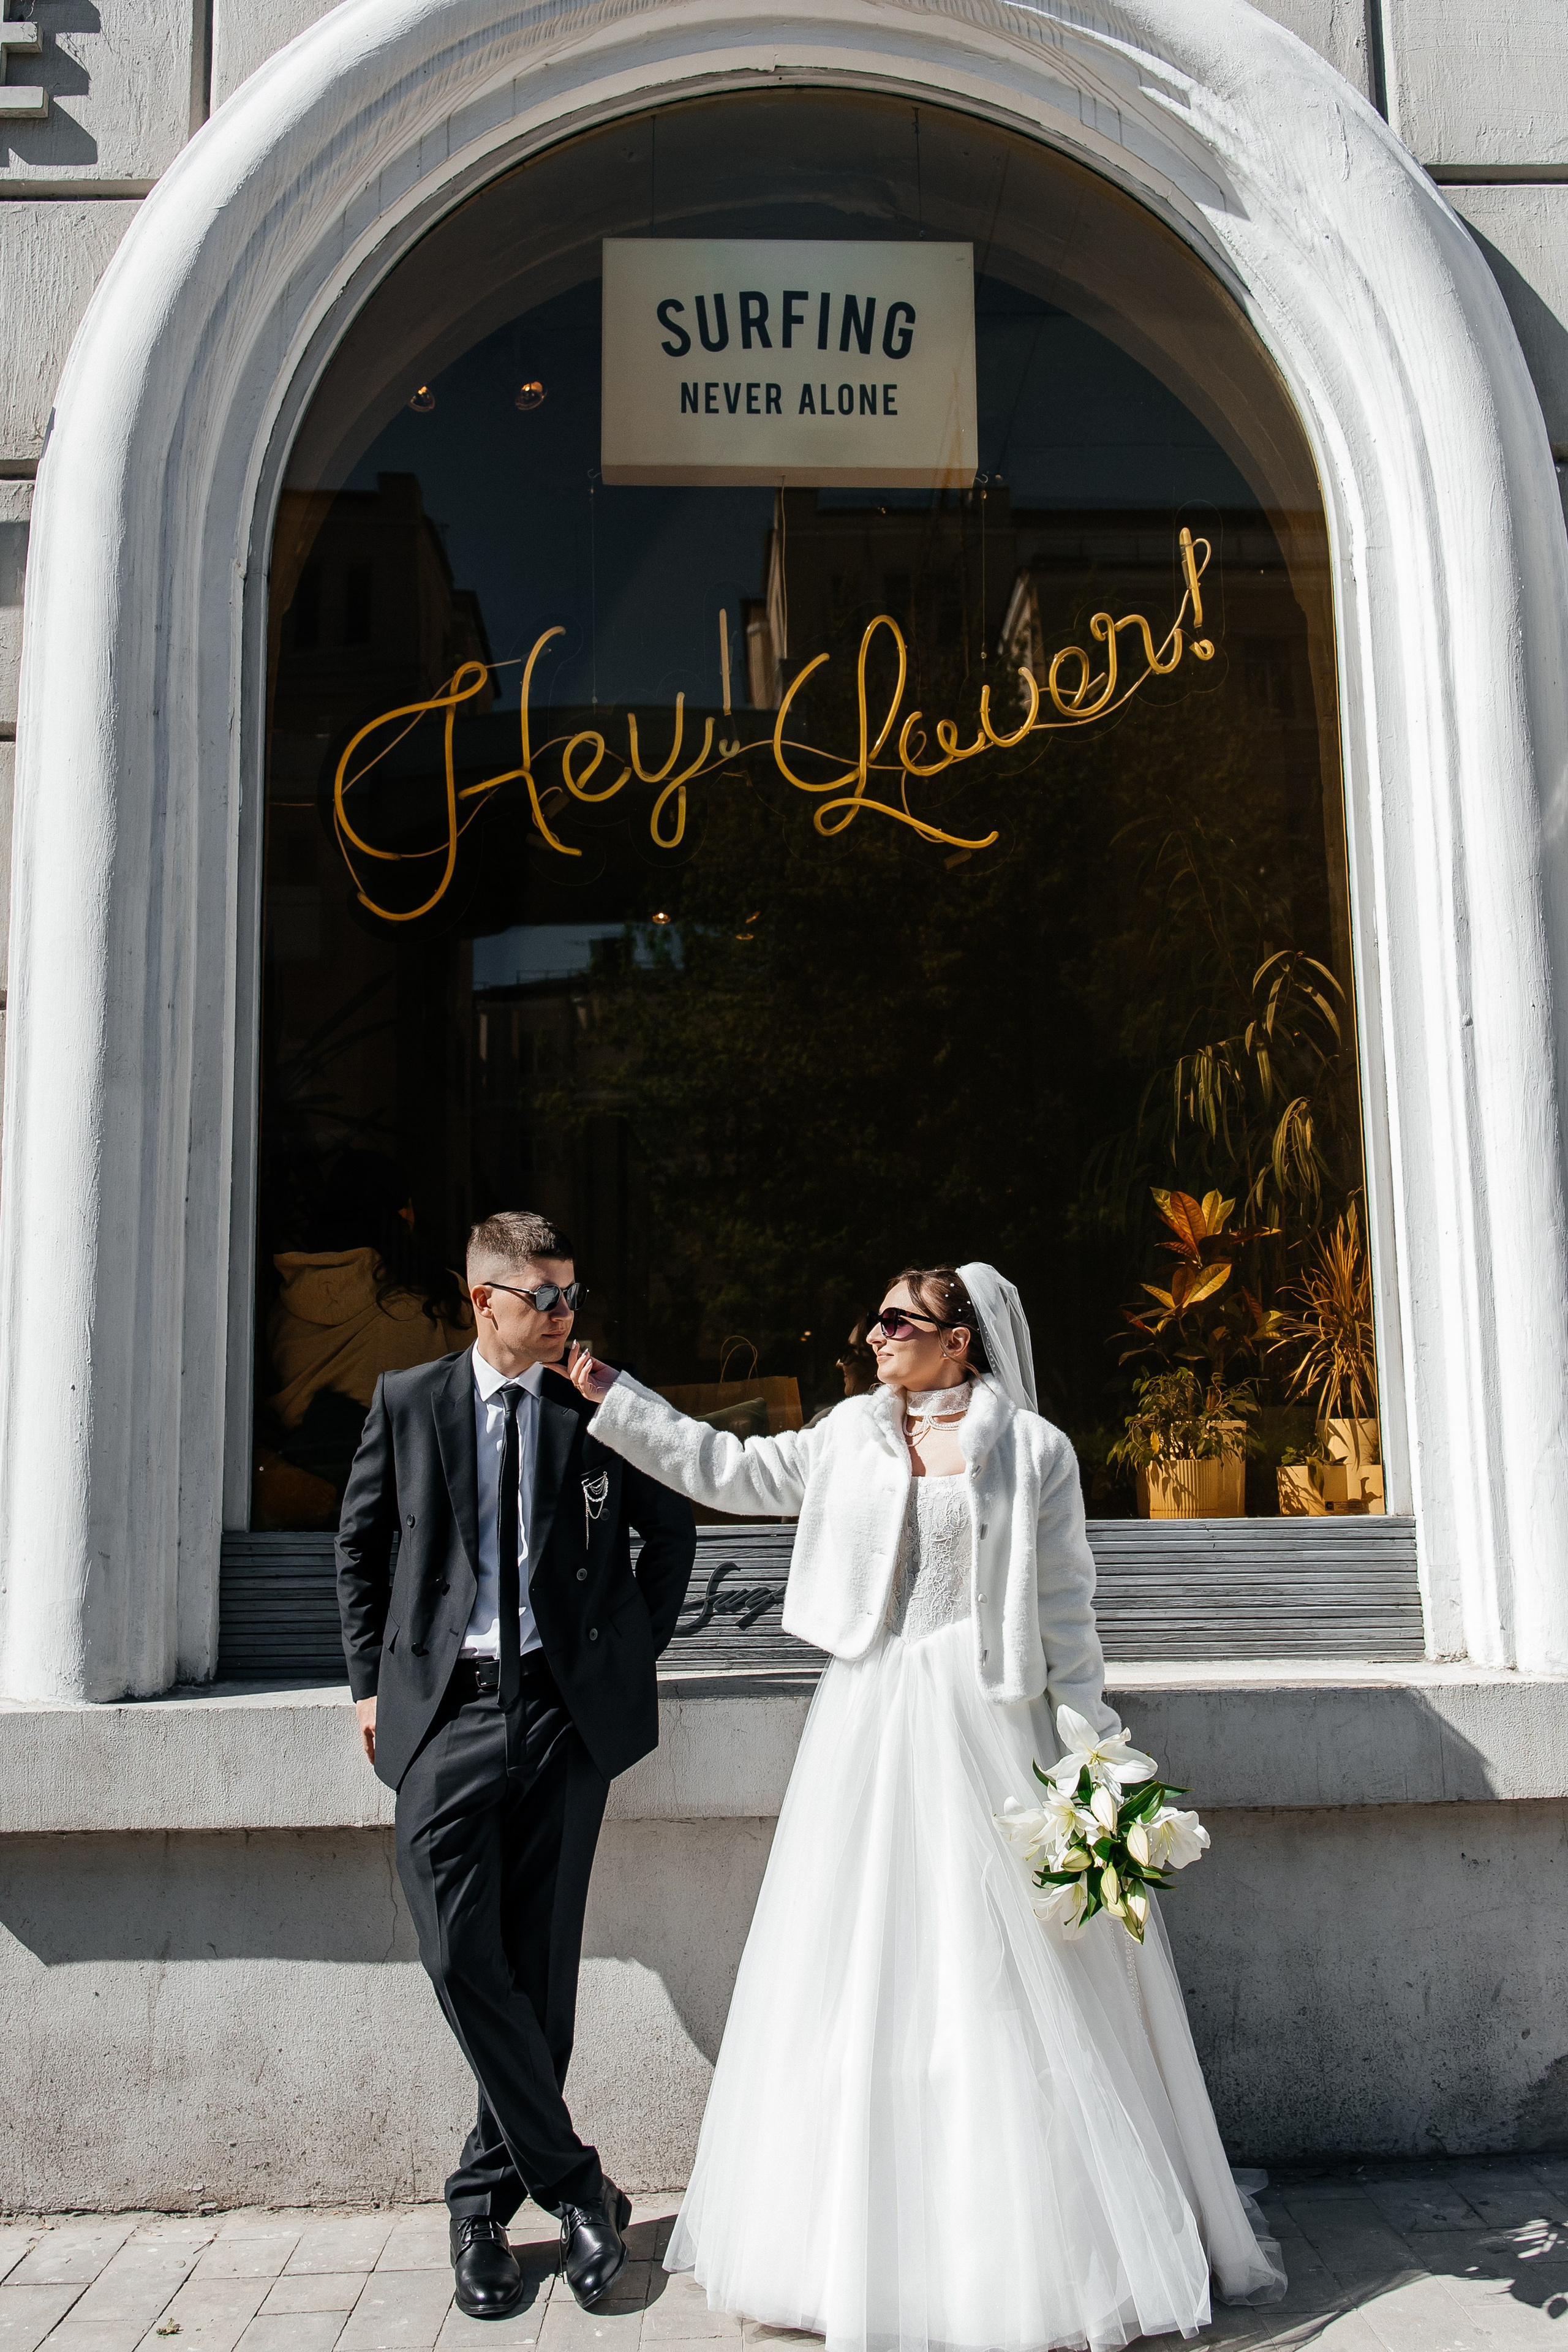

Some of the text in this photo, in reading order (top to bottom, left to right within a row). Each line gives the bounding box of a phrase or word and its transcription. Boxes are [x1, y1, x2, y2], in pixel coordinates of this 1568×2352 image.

[655, 290, 916, 360] SURFING
[680, 382, 899, 416] NEVER ALONE
